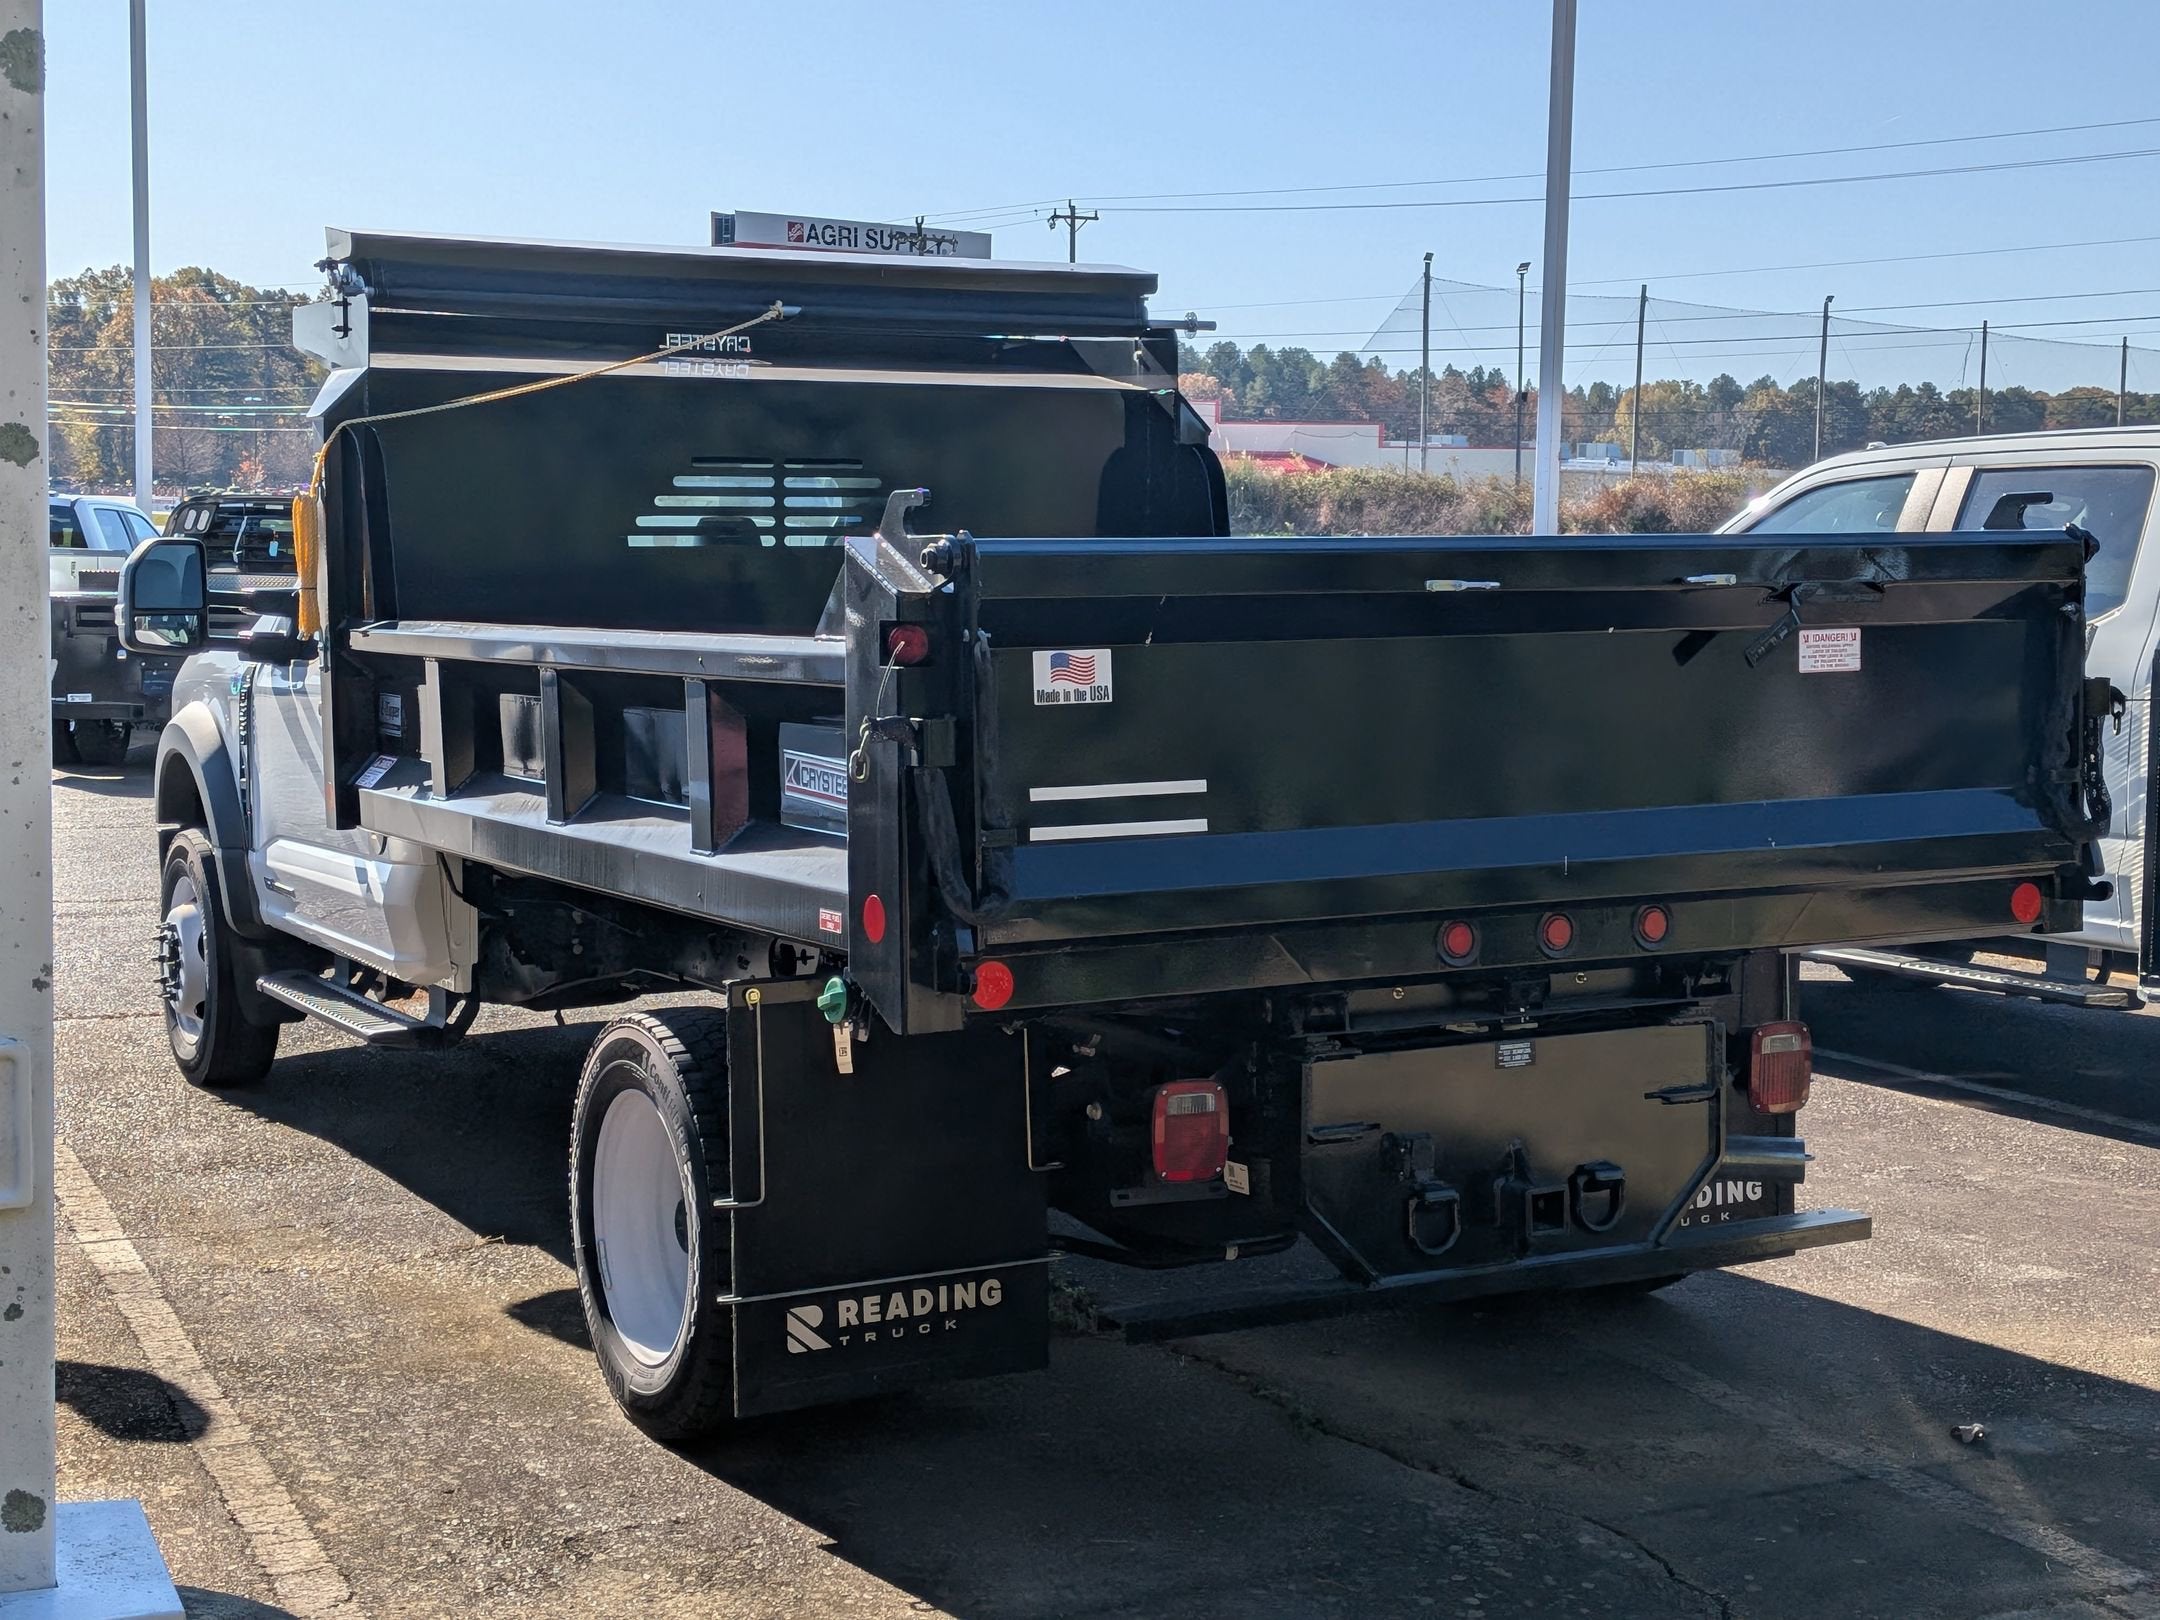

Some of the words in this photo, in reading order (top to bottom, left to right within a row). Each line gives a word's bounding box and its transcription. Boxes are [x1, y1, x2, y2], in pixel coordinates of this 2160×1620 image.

[806, 223, 859, 248] AGRI
[1036, 689, 1061, 703] Made
[1063, 688, 1071, 702] in
[1074, 688, 1087, 702] the
[1089, 685, 1110, 702] USA
[801, 766, 847, 796] CRYSTEE
[1689, 1181, 1763, 1210] DING
[1680, 1212, 1730, 1227] UCK
[838, 1278, 1003, 1328] READING
[839, 1319, 957, 1346] TRUCK
